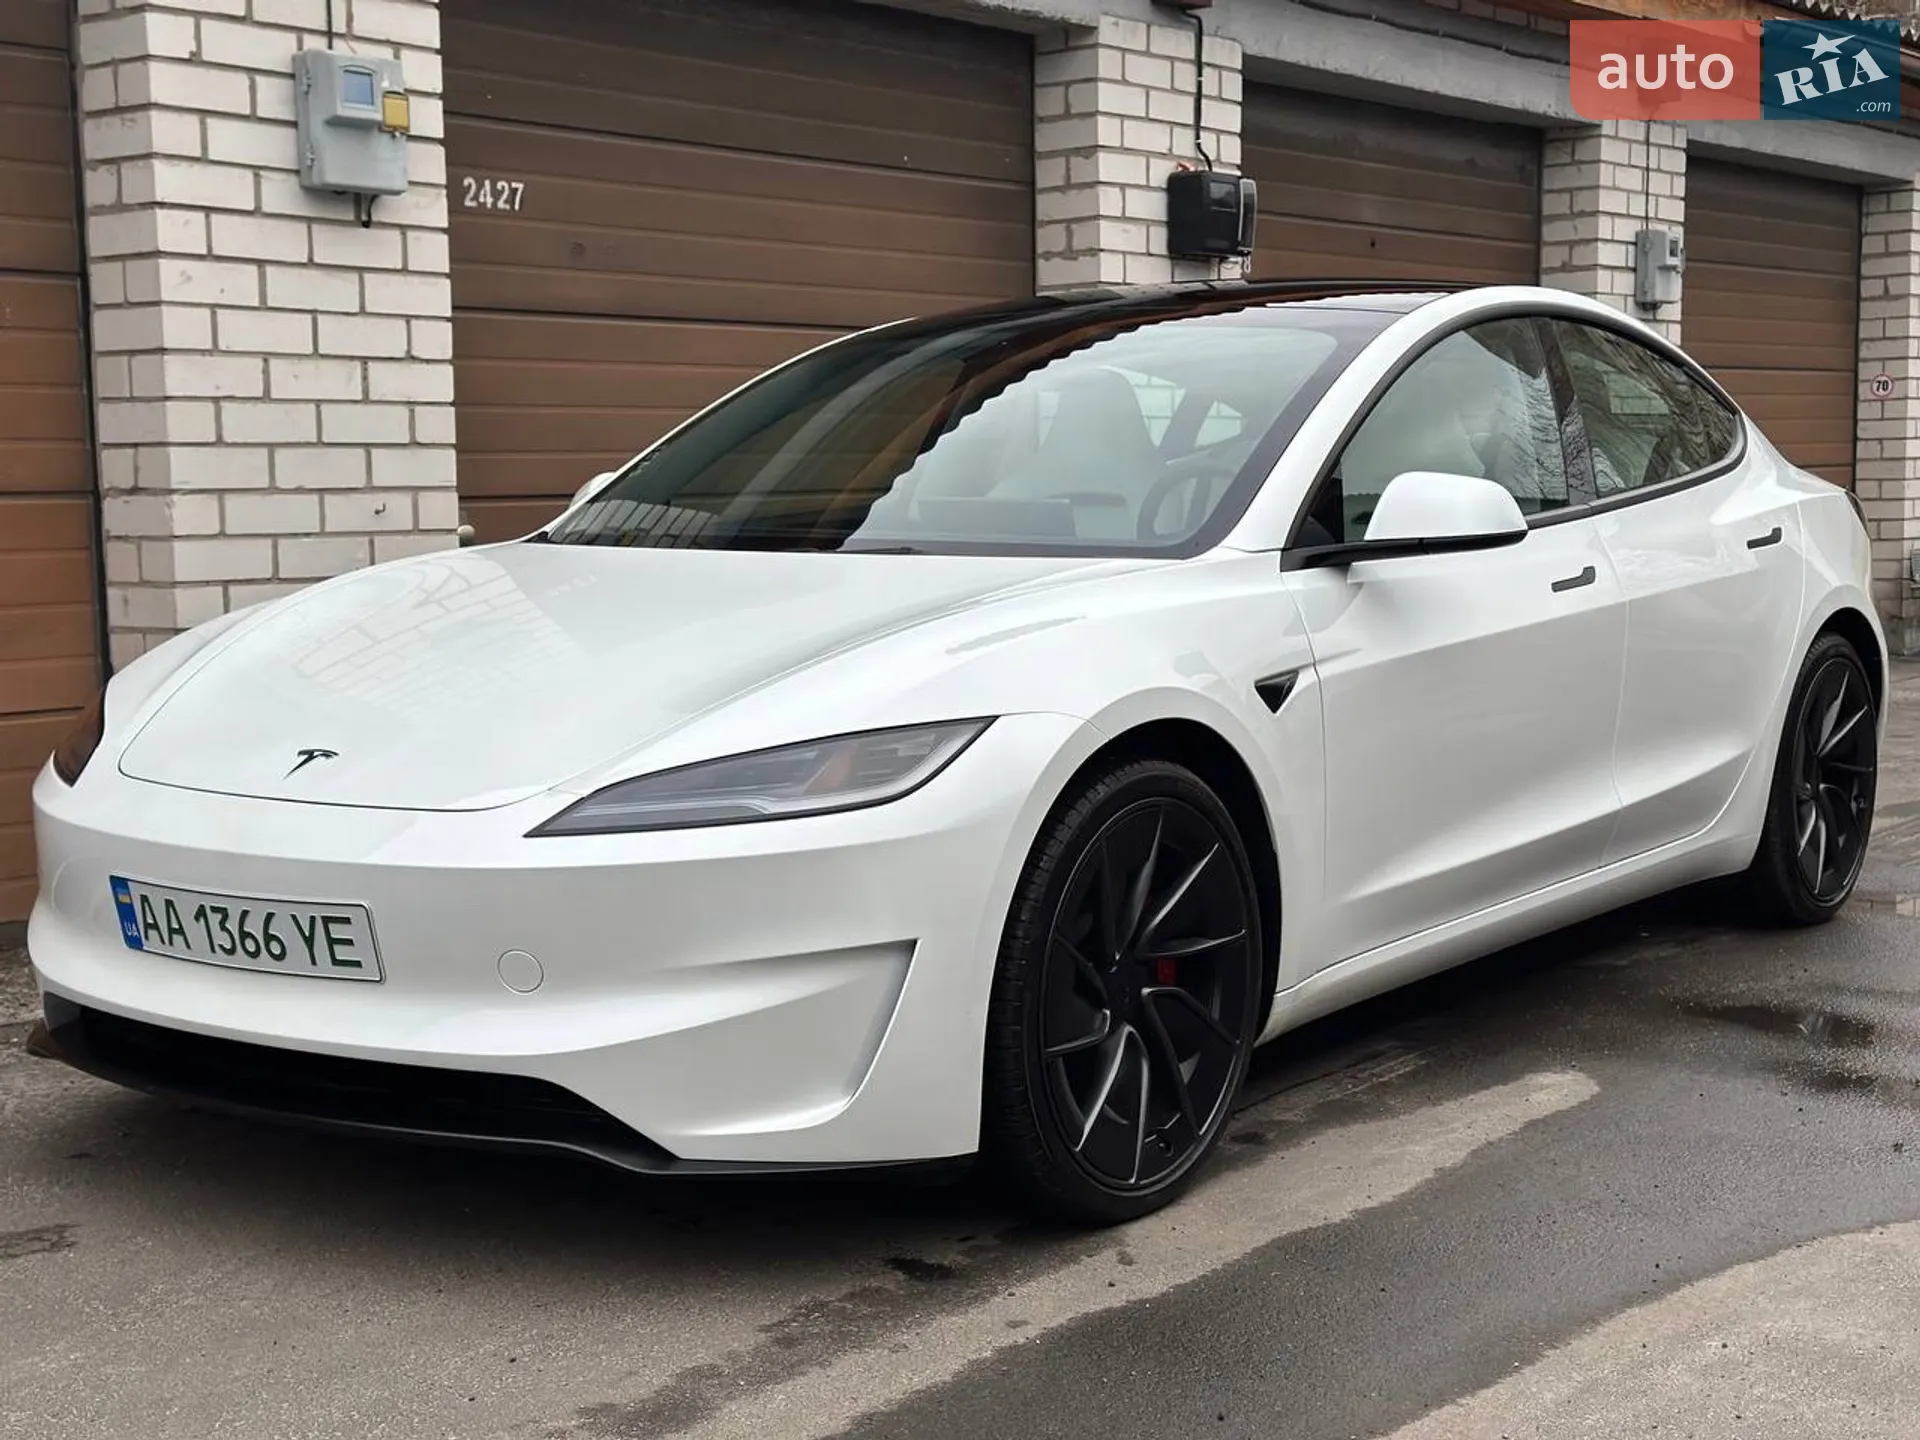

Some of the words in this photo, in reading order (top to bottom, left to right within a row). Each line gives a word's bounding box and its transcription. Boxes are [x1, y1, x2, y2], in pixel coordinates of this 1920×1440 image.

[462, 176, 525, 211] 2427
[1875, 379, 1890, 392] 70
[123, 920, 140, 938] UA
[139, 893, 192, 950] AA
[193, 904, 287, 962] 1366
[290, 913, 363, 969] YE
